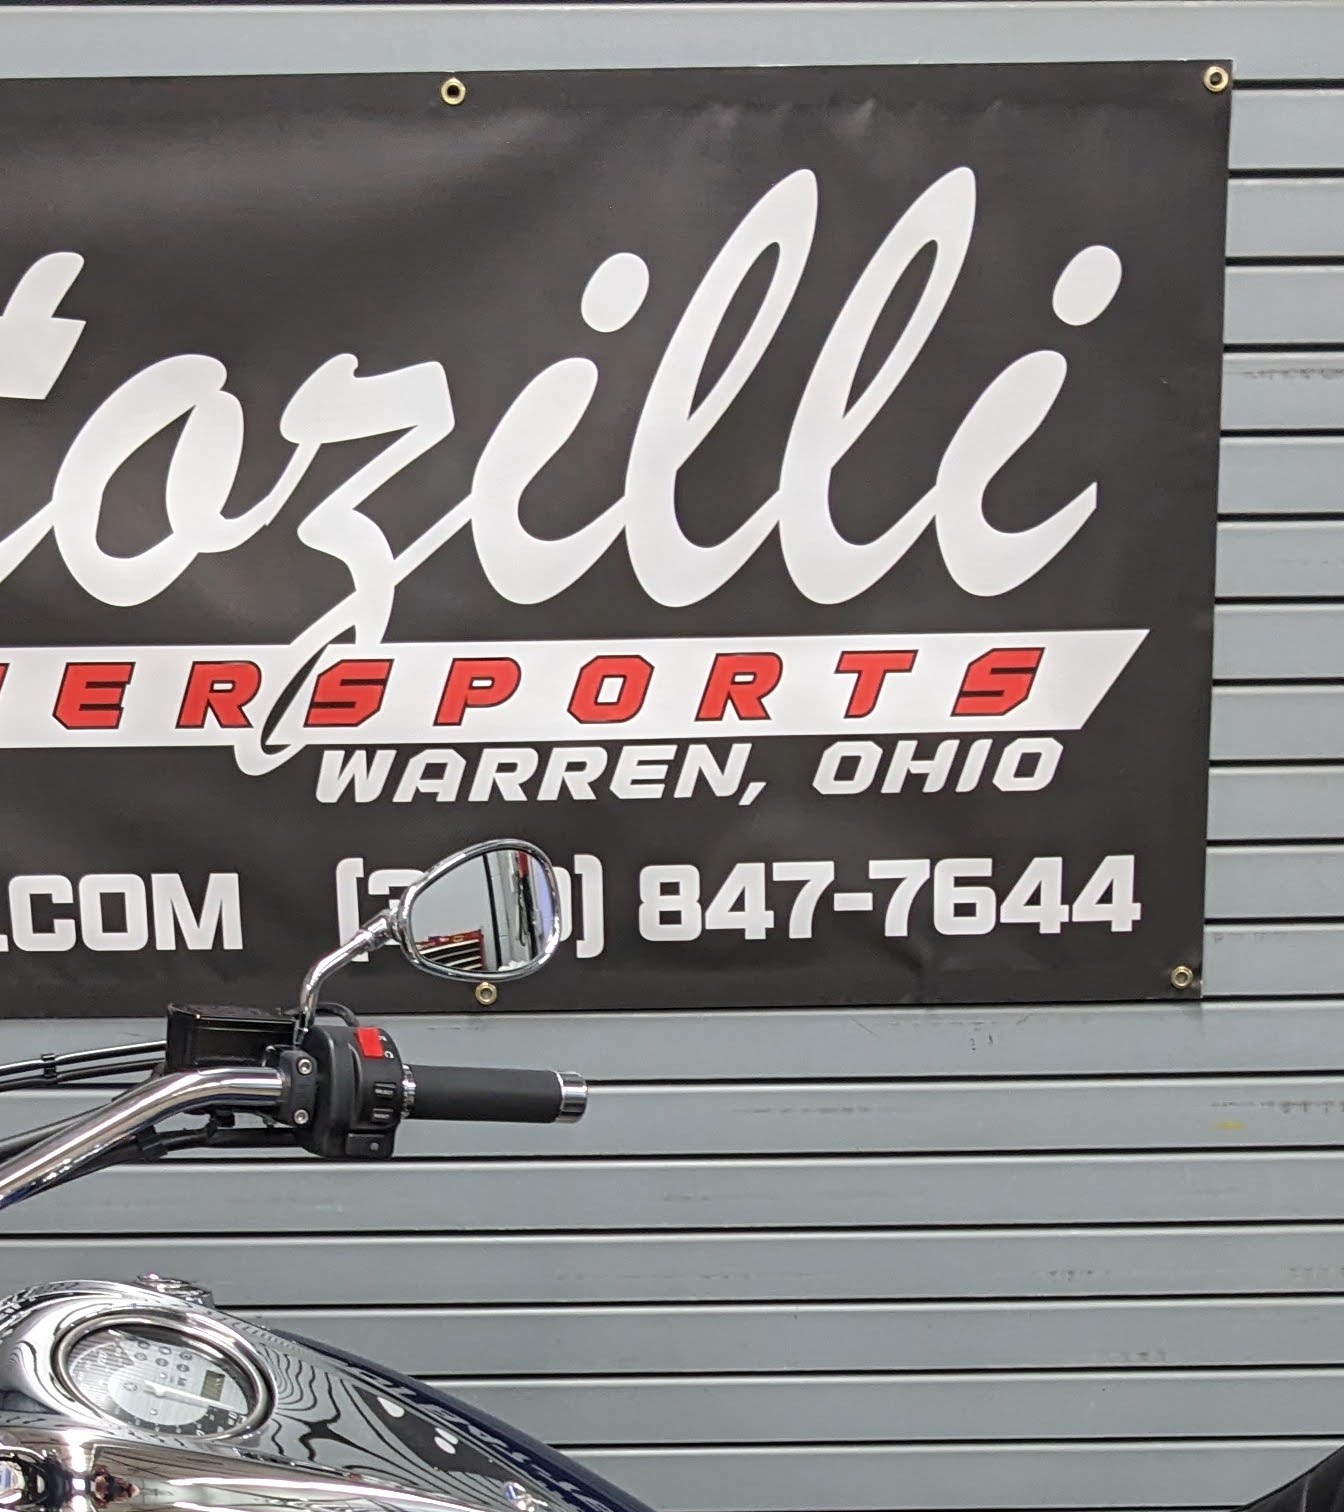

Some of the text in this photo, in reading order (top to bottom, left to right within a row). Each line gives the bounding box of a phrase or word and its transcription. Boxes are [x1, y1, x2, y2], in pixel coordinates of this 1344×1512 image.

[315, 737, 1063, 806] WARREN, OHIO
[638, 854, 1142, 942] 847-7644
